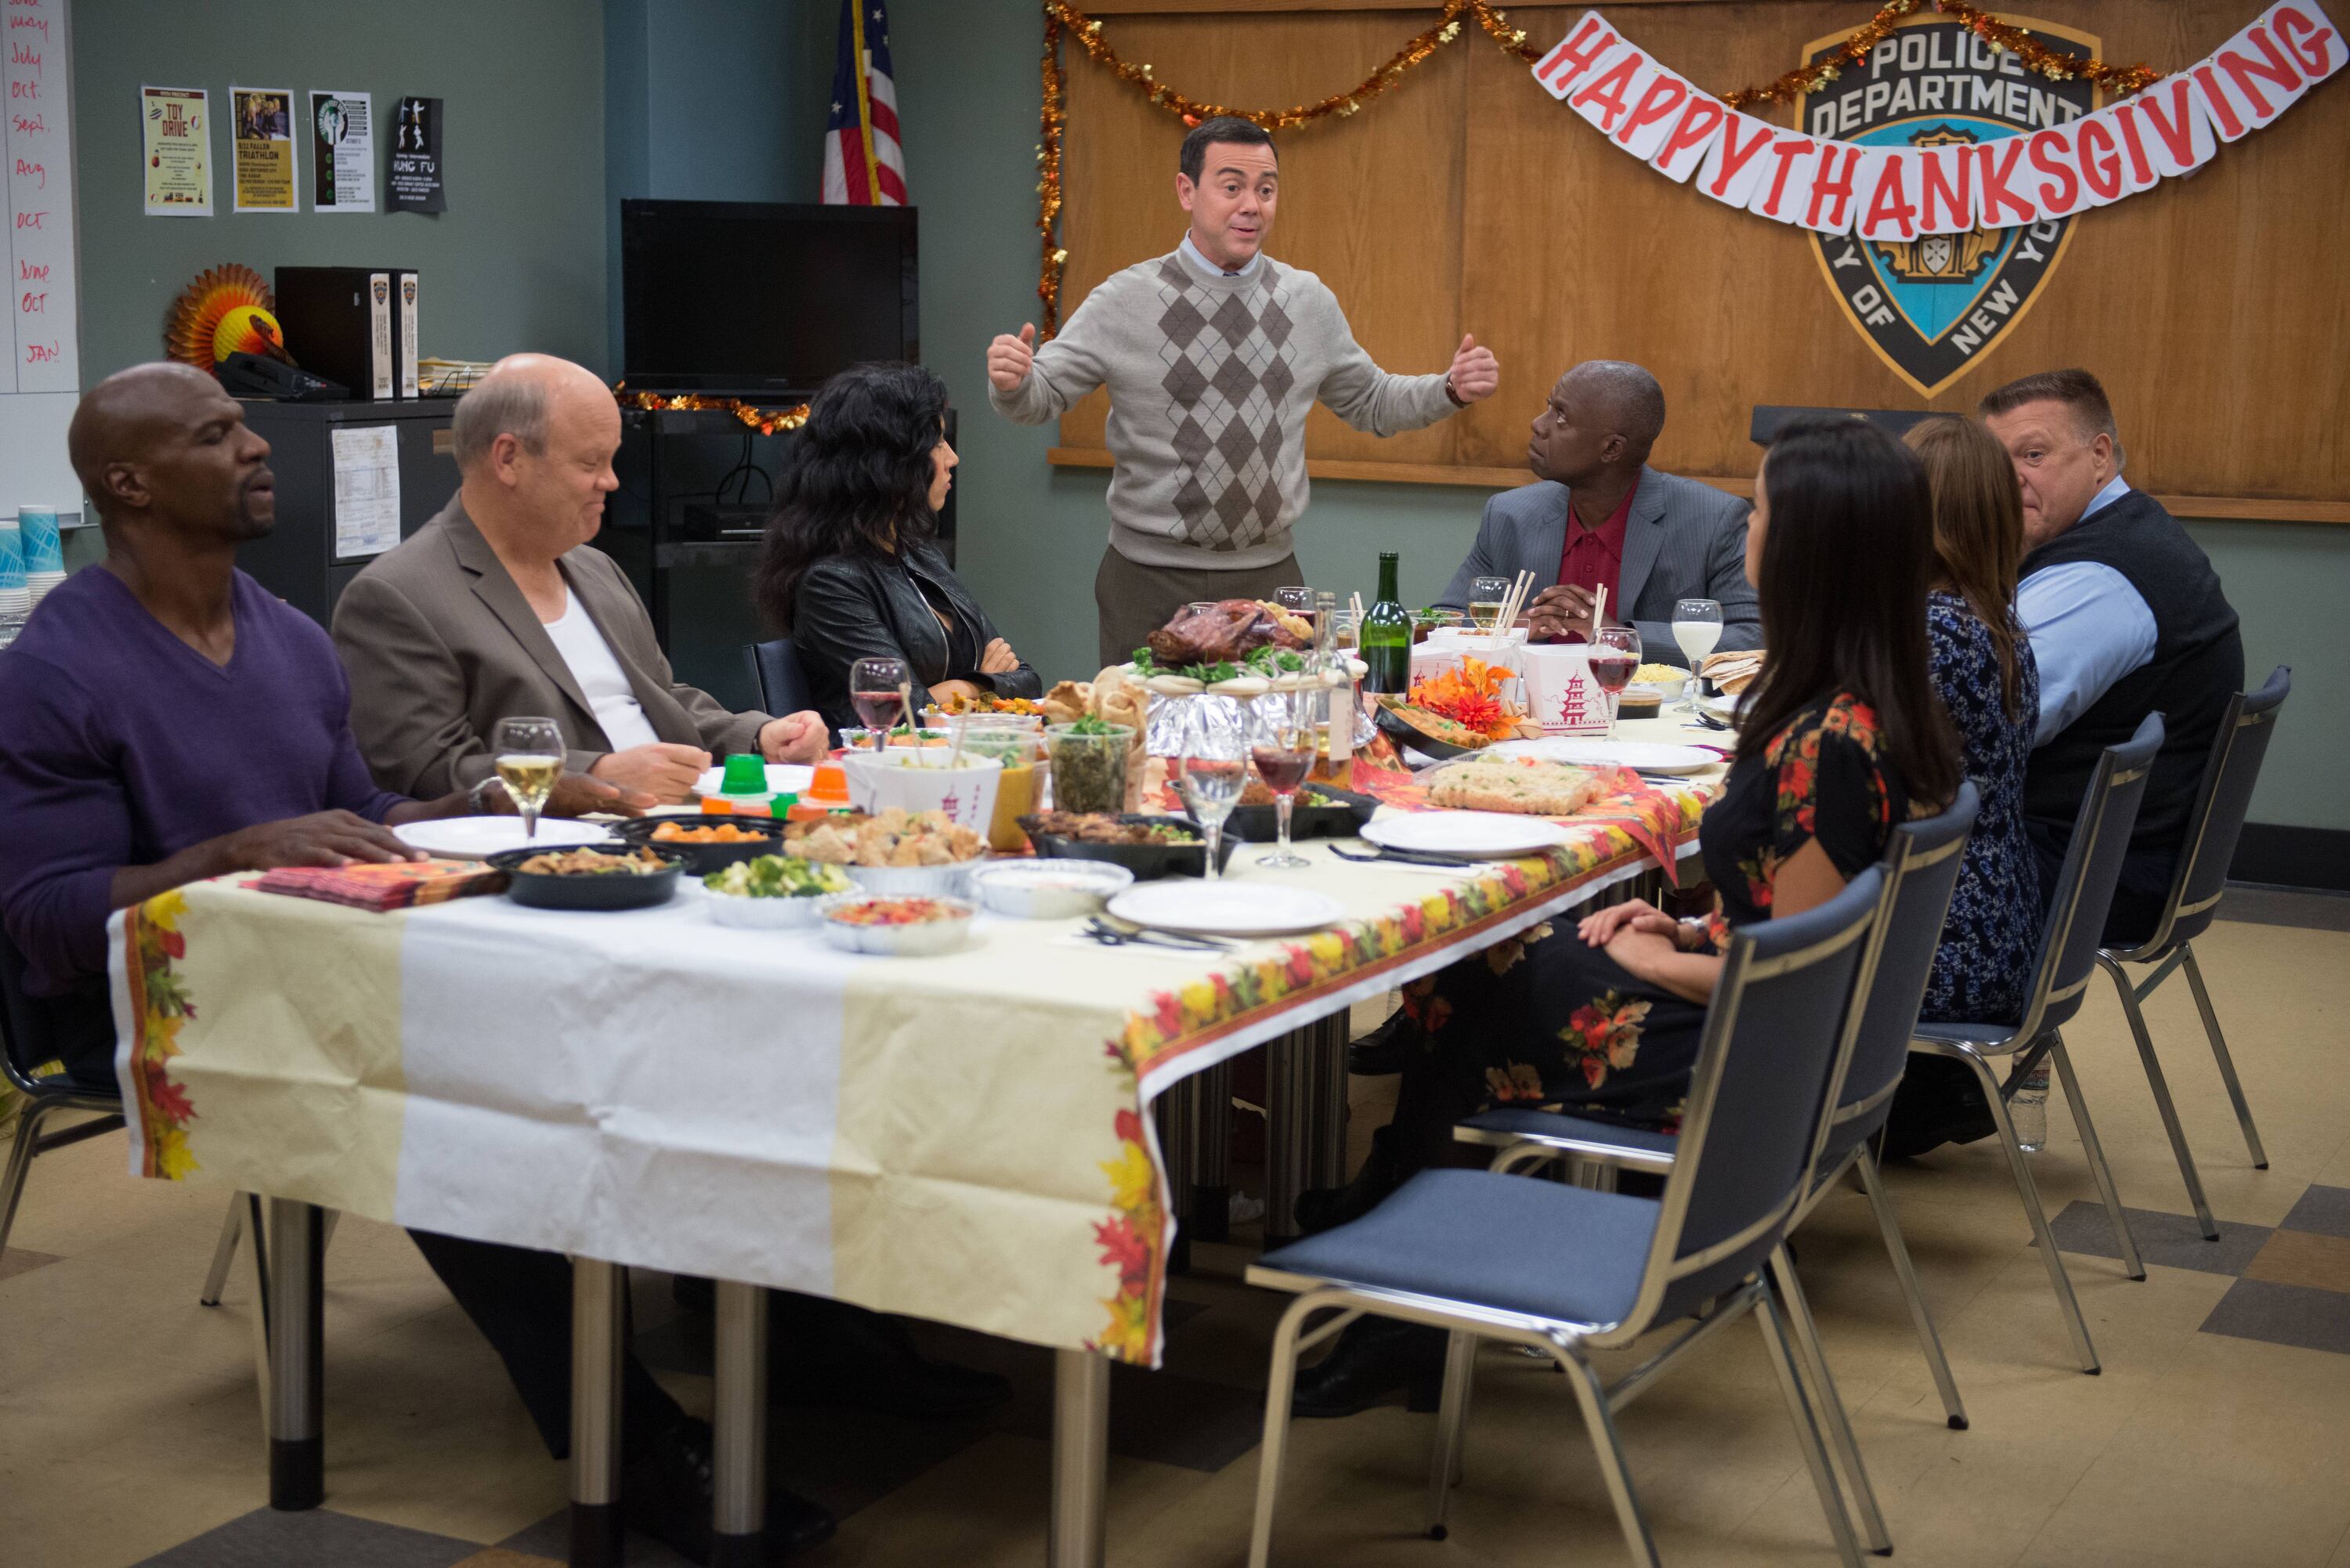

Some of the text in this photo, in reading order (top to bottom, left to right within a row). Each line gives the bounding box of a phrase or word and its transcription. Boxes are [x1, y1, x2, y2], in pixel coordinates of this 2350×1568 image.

[11, 42, 42, 79] July
[1872, 31, 2025, 79] POLICE
[165, 103, 183, 120] TOY
[1538, 6, 2333, 238] HAPPY THANKSGIVING
[1812, 74, 2083, 141] DEPARTMENT
[162, 120, 189, 137] DRIVE
[238, 150, 279, 160] TRIATHLON
[393, 160, 436, 173] KUNG FU
[16, 158, 45, 190] Aug
[1852, 219, 2060, 356] OF NEW YO
